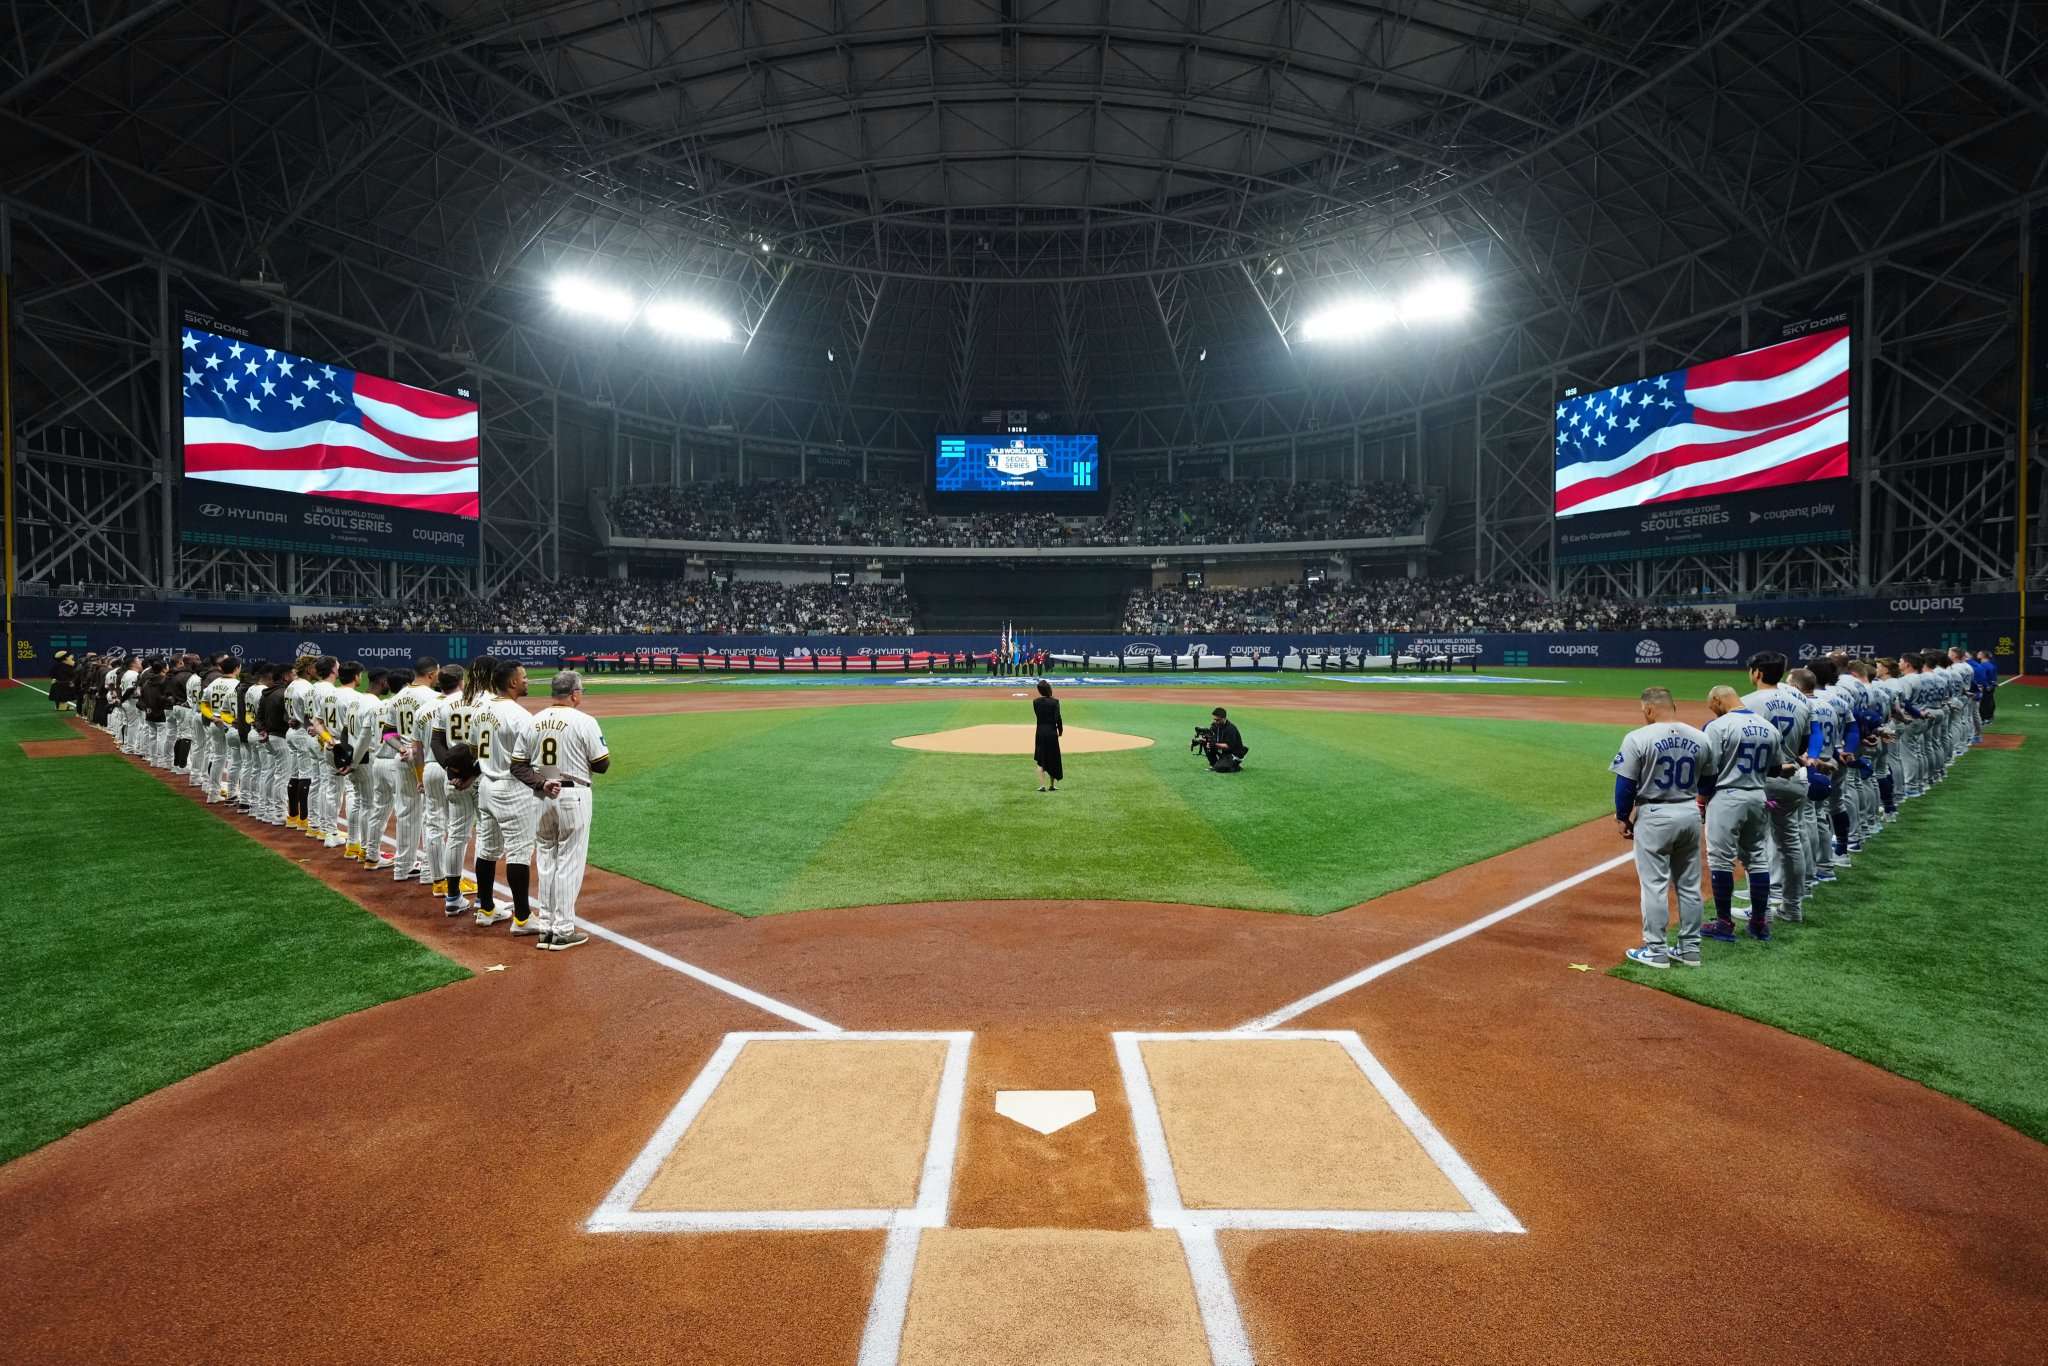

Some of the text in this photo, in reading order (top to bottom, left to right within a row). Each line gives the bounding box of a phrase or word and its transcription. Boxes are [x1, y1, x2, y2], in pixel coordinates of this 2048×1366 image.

[1810, 312, 1848, 328] DOME
[213, 321, 249, 337] DOME
[227, 507, 288, 524] HYUNDAI
[1640, 510, 1730, 532] SEOUL SERIES
[1763, 503, 1836, 522] coupang play
[303, 512, 393, 534] SEOUL SERIES
[412, 528, 465, 547] coupang
[80, 601, 136, 618] 로켓직구
[1890, 597, 1964, 614] coupang
[358, 647, 412, 660] coupang
[486, 646, 566, 656] SEOUL SERIES
[759, 645, 777, 657] play
[813, 646, 842, 656] KOSÉ
[1230, 645, 1271, 656] coupang
[1407, 644, 1483, 654] SEOUL SERIES
[1548, 644, 1599, 656] coupang
[1766, 699, 1797, 713] OHTANI
[325, 707, 336, 728] 14
[535, 719, 569, 733] SHILDT
[1742, 726, 1770, 738] BETTS
[479, 730, 490, 758] 2
[542, 737, 557, 766] 8
[1655, 736, 1700, 754] ROBERTS
[1737, 742, 1771, 774] 50
[1654, 755, 1695, 790] 30
